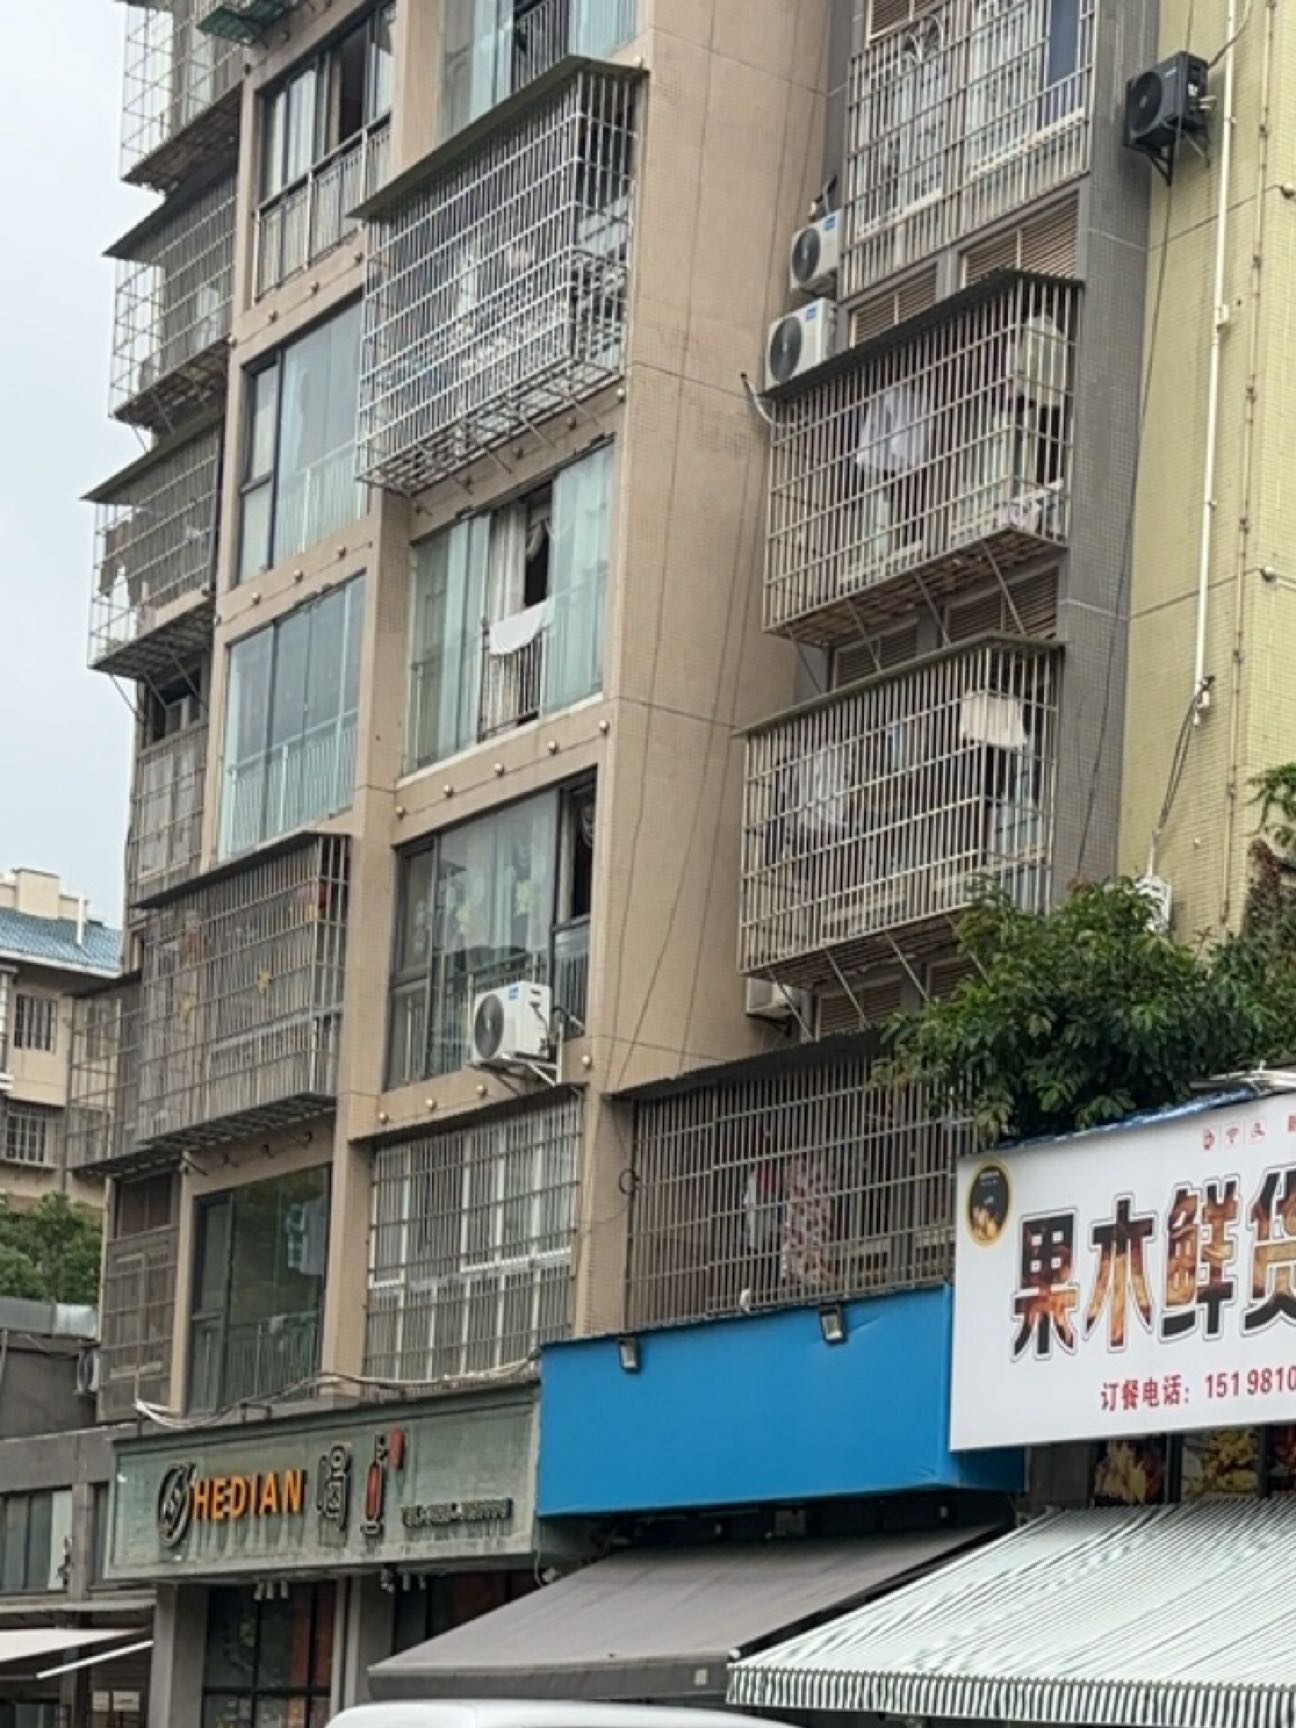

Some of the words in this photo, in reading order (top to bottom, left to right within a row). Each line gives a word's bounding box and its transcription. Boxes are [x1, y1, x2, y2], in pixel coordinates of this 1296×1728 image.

[1100, 1374, 1190, 1412] 订餐电话：
[1205, 1370, 1240, 1399] 151
